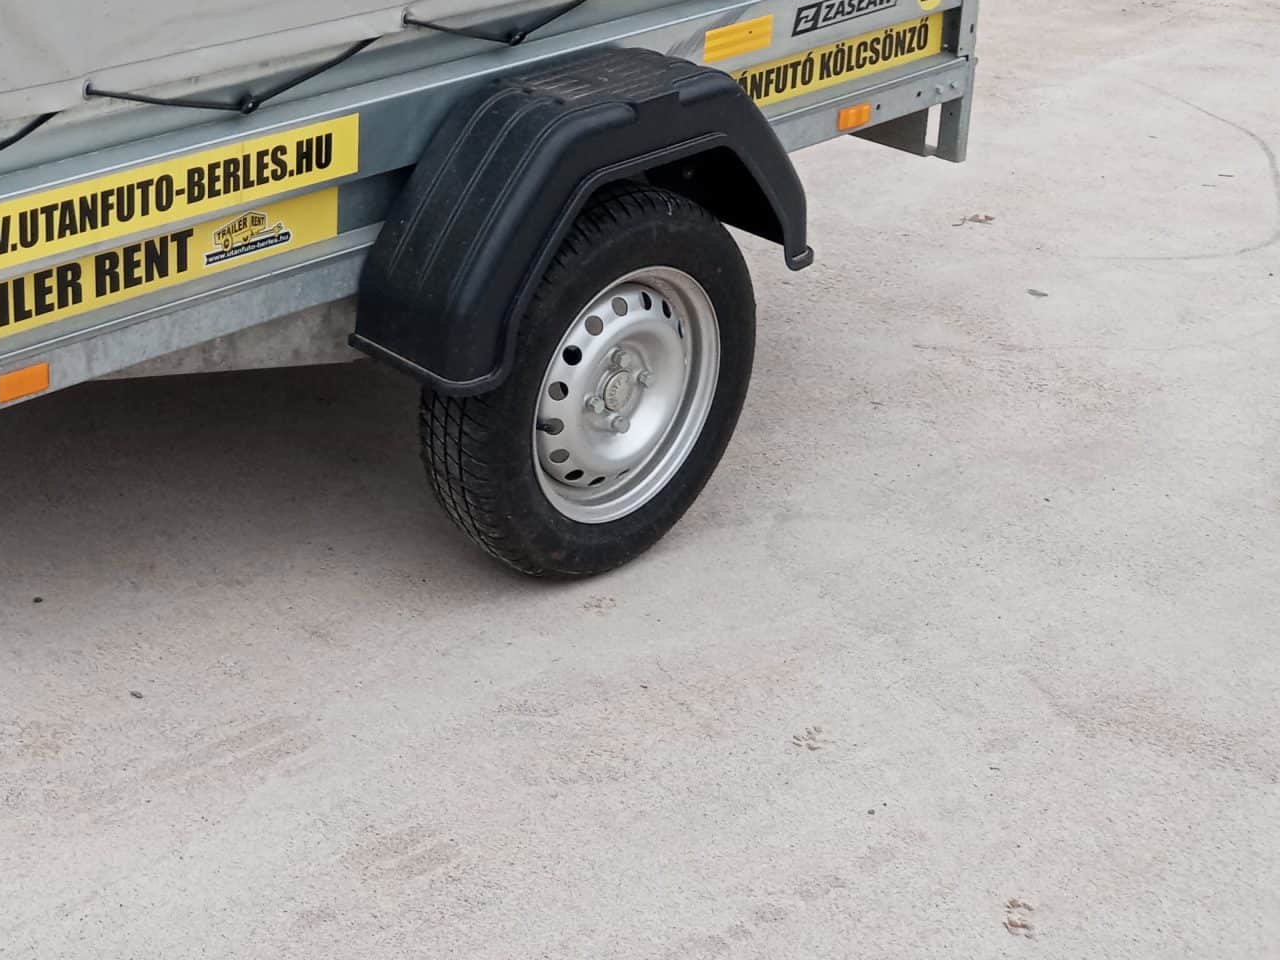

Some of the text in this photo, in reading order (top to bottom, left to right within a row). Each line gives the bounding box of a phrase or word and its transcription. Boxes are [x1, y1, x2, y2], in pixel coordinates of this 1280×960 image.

[737, 16, 929, 100] ÁNFUTÓ KÖLCSÖNZŐ
[94, 228, 194, 309] RENT
[216, 216, 248, 241] TRAILER
